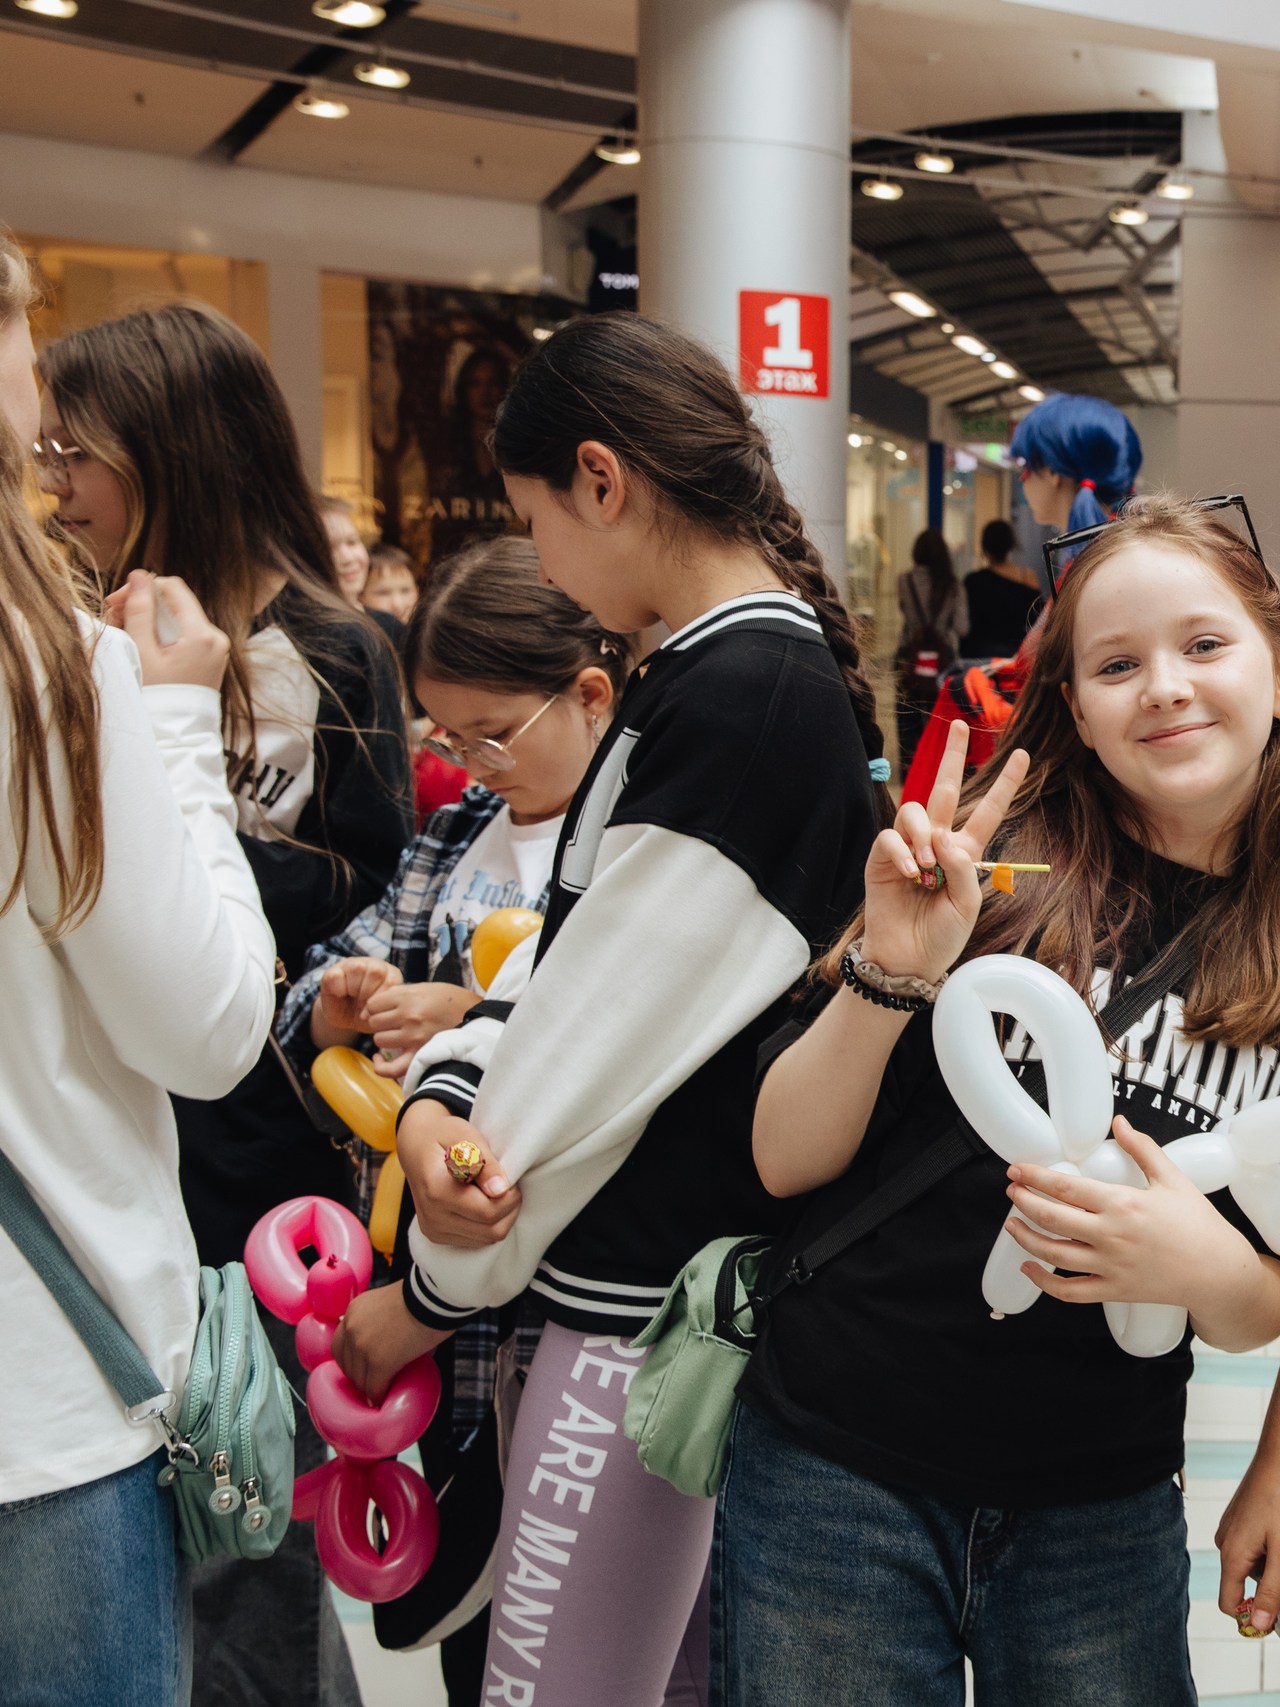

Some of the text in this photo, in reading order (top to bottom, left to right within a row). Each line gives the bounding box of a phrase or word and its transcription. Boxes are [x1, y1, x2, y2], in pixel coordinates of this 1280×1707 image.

[762, 297, 814, 370] 1
[528, 1390, 617, 1514] ARE
[496, 1509, 579, 1670] MANY
[484, 1661, 536, 1707] R
